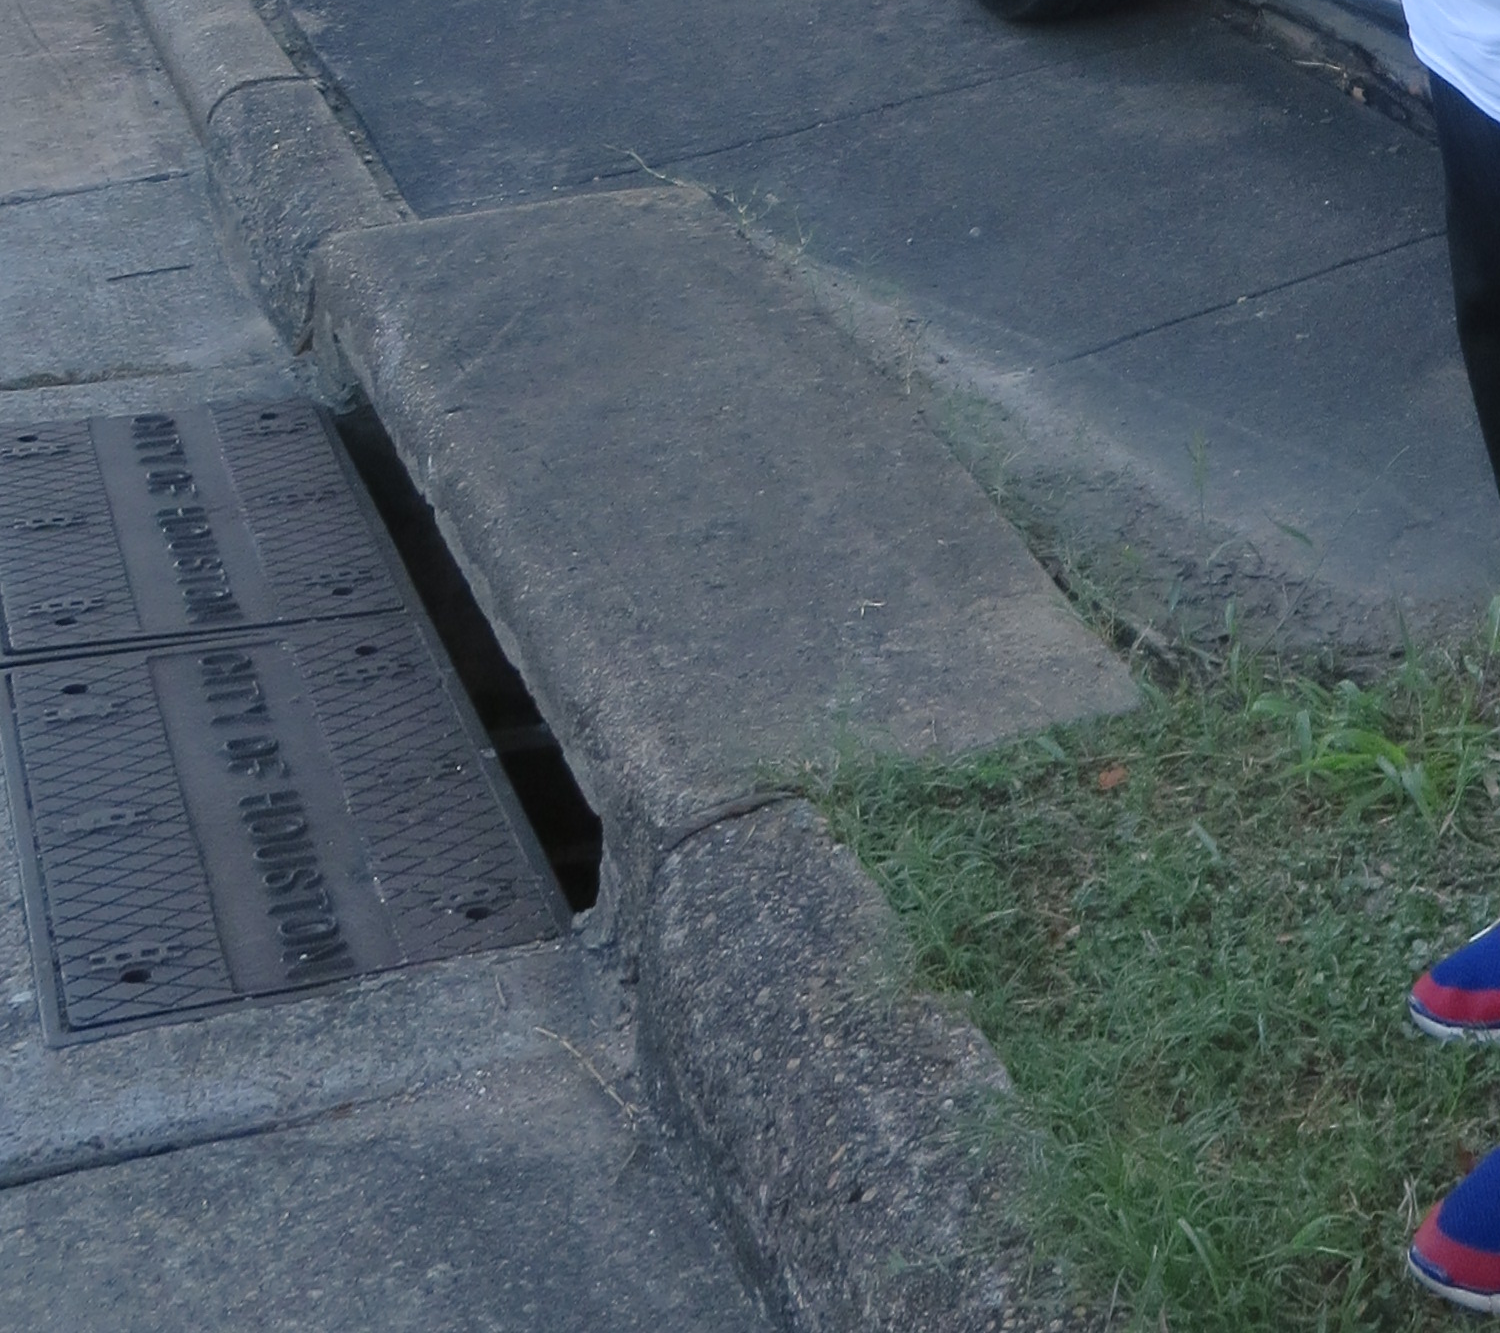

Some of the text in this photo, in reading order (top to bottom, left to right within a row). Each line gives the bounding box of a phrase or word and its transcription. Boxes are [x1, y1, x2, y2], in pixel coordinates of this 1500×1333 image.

[132, 412, 190, 465] CITY
[156, 505, 246, 626] HOUSTON
[199, 652, 356, 981] CITY OF HOUSTON
